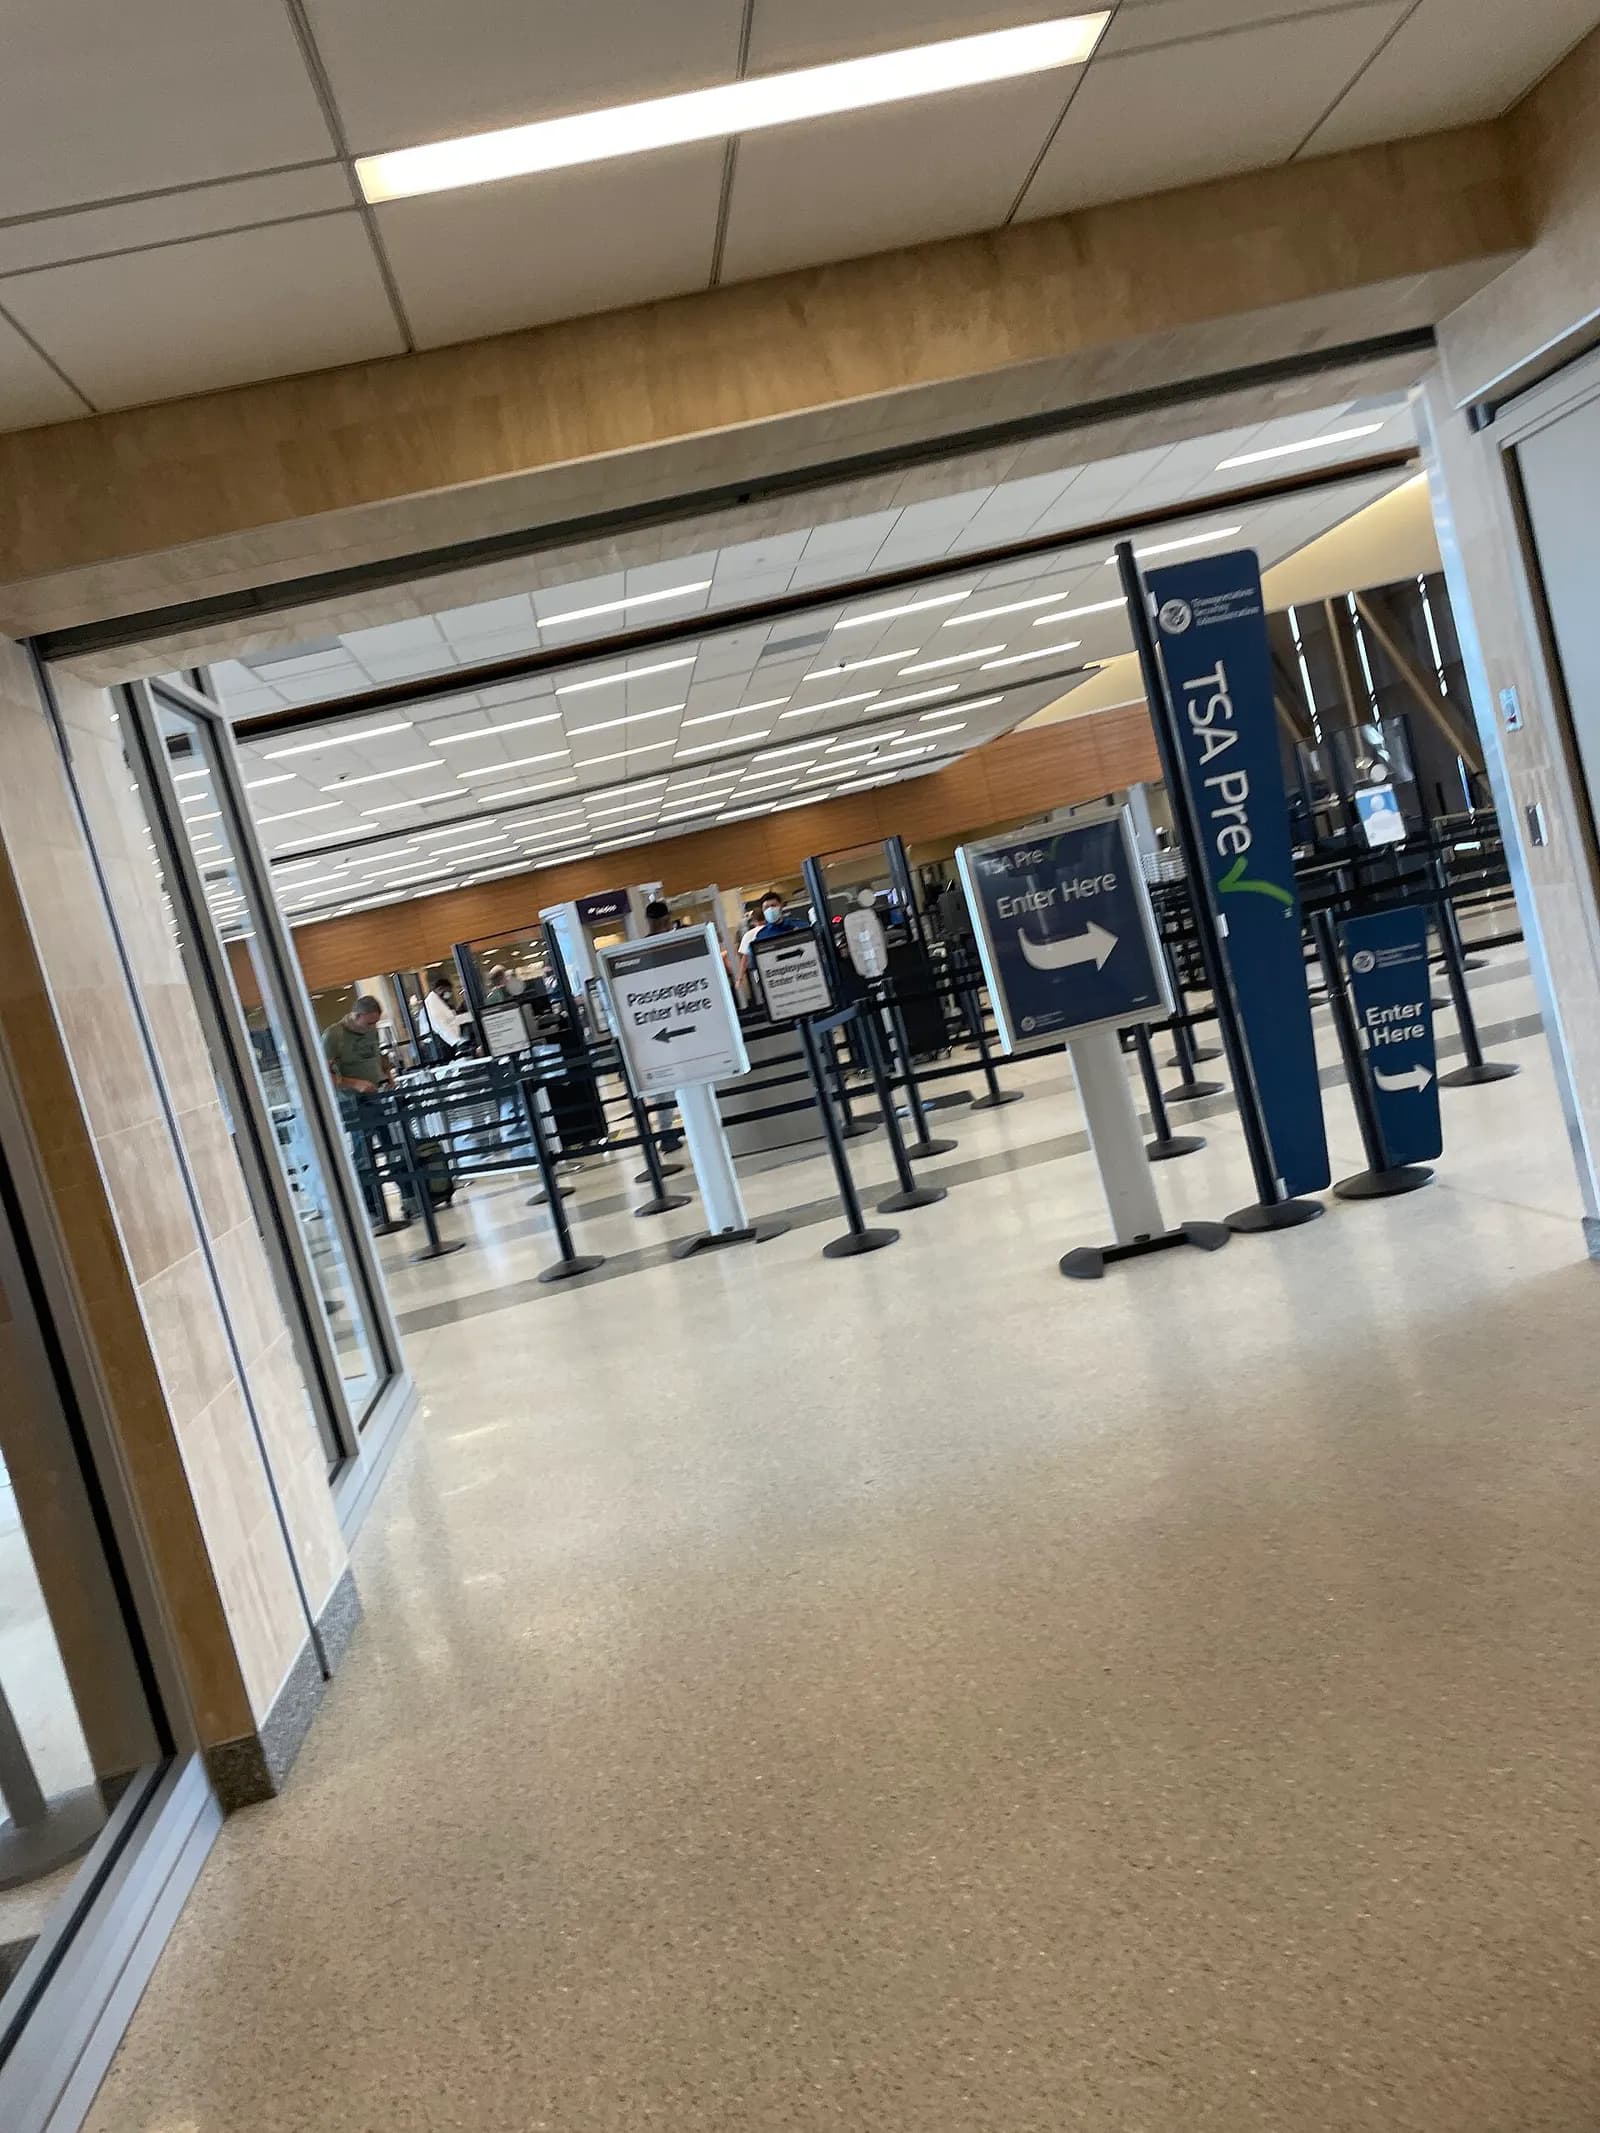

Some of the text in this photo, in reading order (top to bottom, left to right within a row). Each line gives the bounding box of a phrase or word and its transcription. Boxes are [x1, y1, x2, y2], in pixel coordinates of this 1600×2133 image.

[1182, 659, 1239, 767] TSA
[1203, 769, 1252, 857] Pre
[981, 847, 1045, 876] TSA Pre
[997, 872, 1119, 920] Enter Here
[626, 977, 709, 1007] Passengers
[633, 997, 712, 1026] Enter Here
[1365, 1002, 1425, 1027] Enter
[1373, 1023, 1426, 1047] Here
